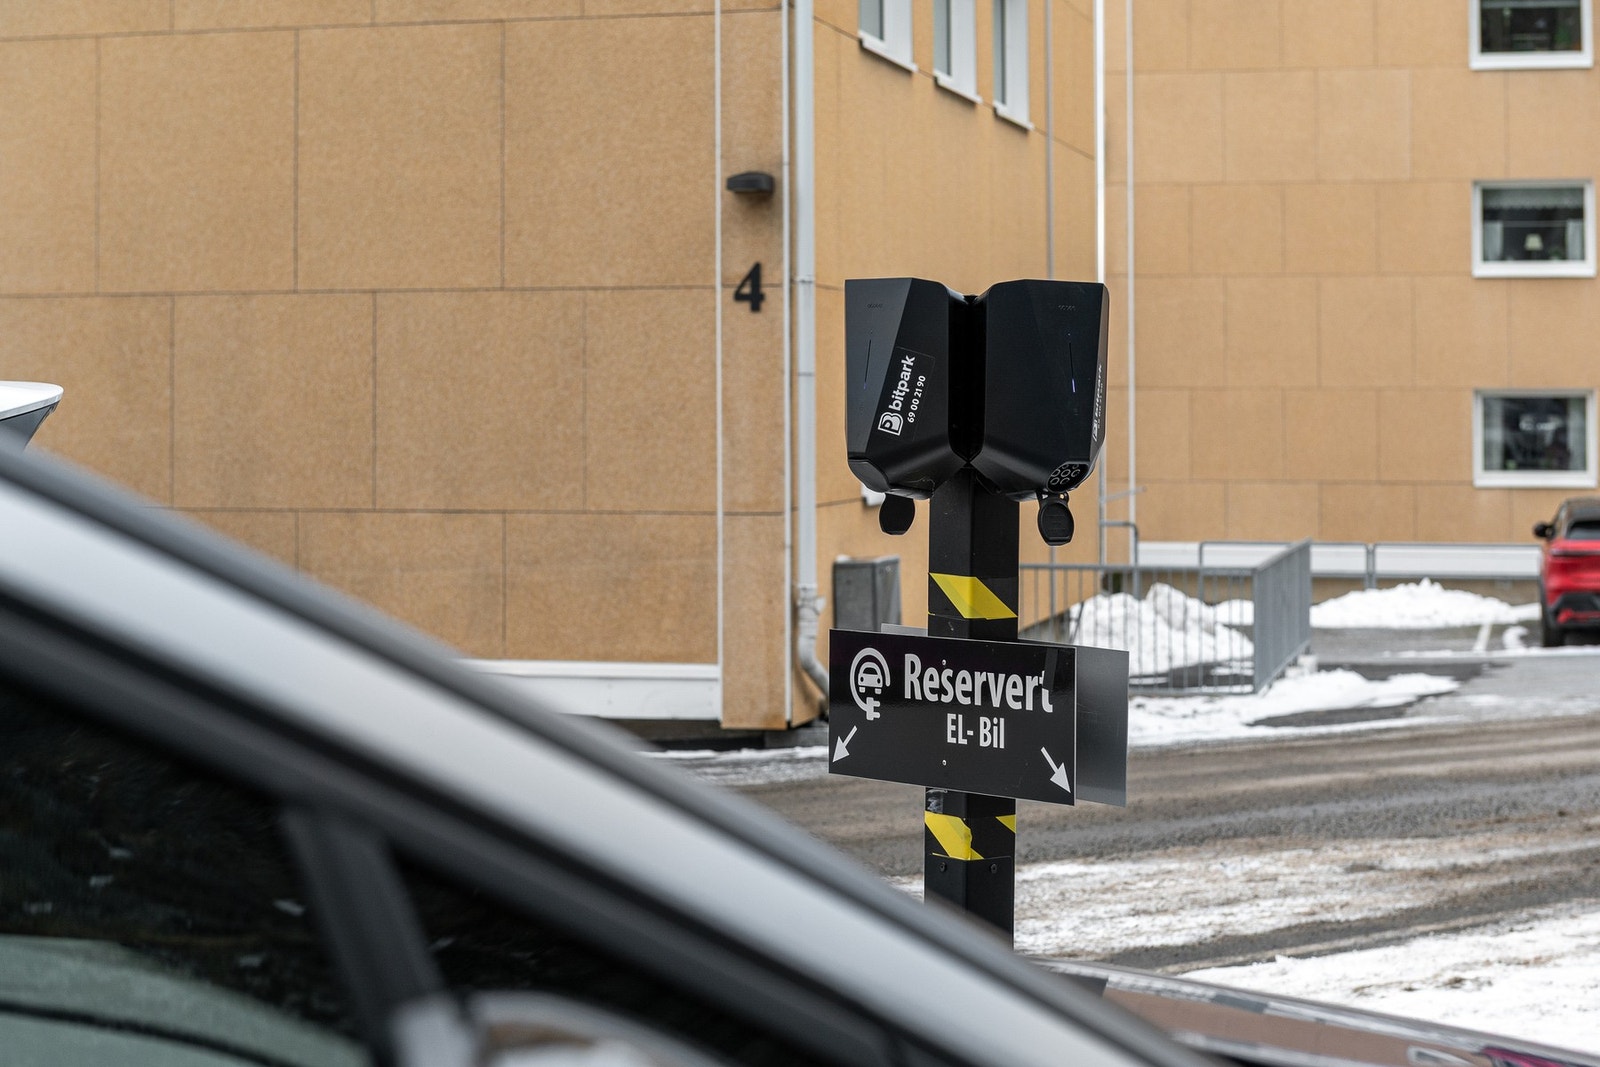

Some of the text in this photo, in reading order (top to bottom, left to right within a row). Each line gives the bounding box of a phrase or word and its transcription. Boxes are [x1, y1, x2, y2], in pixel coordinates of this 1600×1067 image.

[733, 262, 766, 312] 4
[888, 355, 915, 411] bitpark
[907, 375, 926, 423] 69 00 21 90
[904, 653, 1053, 713] Reservert
[979, 716, 1005, 749] Bil
